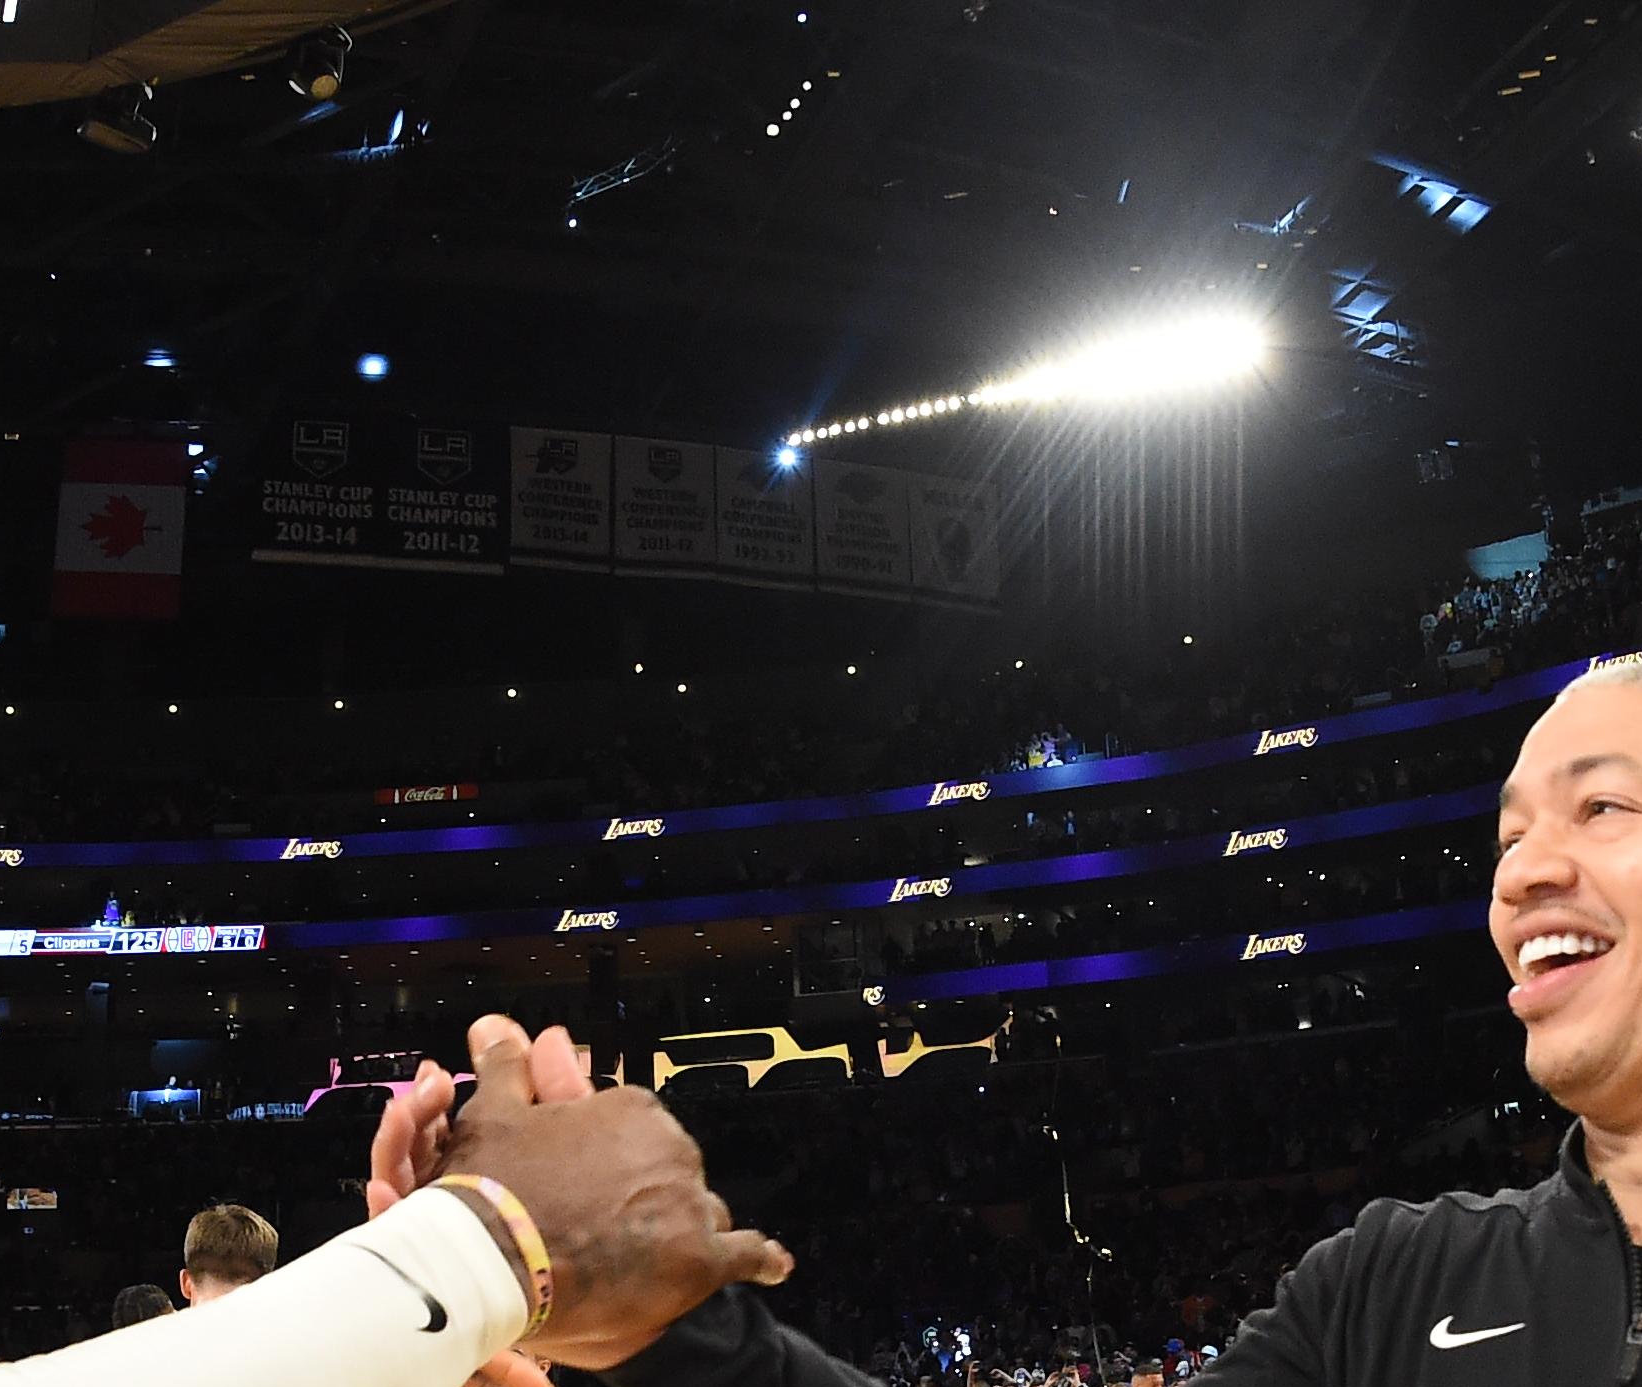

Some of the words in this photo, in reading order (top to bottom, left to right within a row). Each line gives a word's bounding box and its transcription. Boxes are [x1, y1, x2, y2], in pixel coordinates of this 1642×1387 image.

[299, 426, 343, 446] LA
[423, 434, 467, 454] LA
[263, 480, 333, 499] STANLEY
[339, 486, 373, 501] CUP
[388, 488, 459, 506] STANLEY
[464, 493, 497, 509] CUP
[262, 497, 373, 519] CHAMPIONS
[387, 505, 497, 528] CHAMPIONS
[276, 521, 358, 545] 2013-14
[403, 531, 480, 554] 2011-12
[1253, 728, 1318, 755] LAKERS
[927, 782, 991, 806] LAKERS
[602, 818, 665, 840] LAKERS
[280, 838, 343, 859] LAKERS
[1222, 829, 1288, 856] LAKERS
[888, 878, 952, 902] LAKERS
[554, 910, 619, 931] LAKERS
[19, 939, 29, 954] 5
[43, 936, 100, 951] Clippers
[118, 931, 158, 950] 125
[1240, 934, 1307, 960] LAKERS
